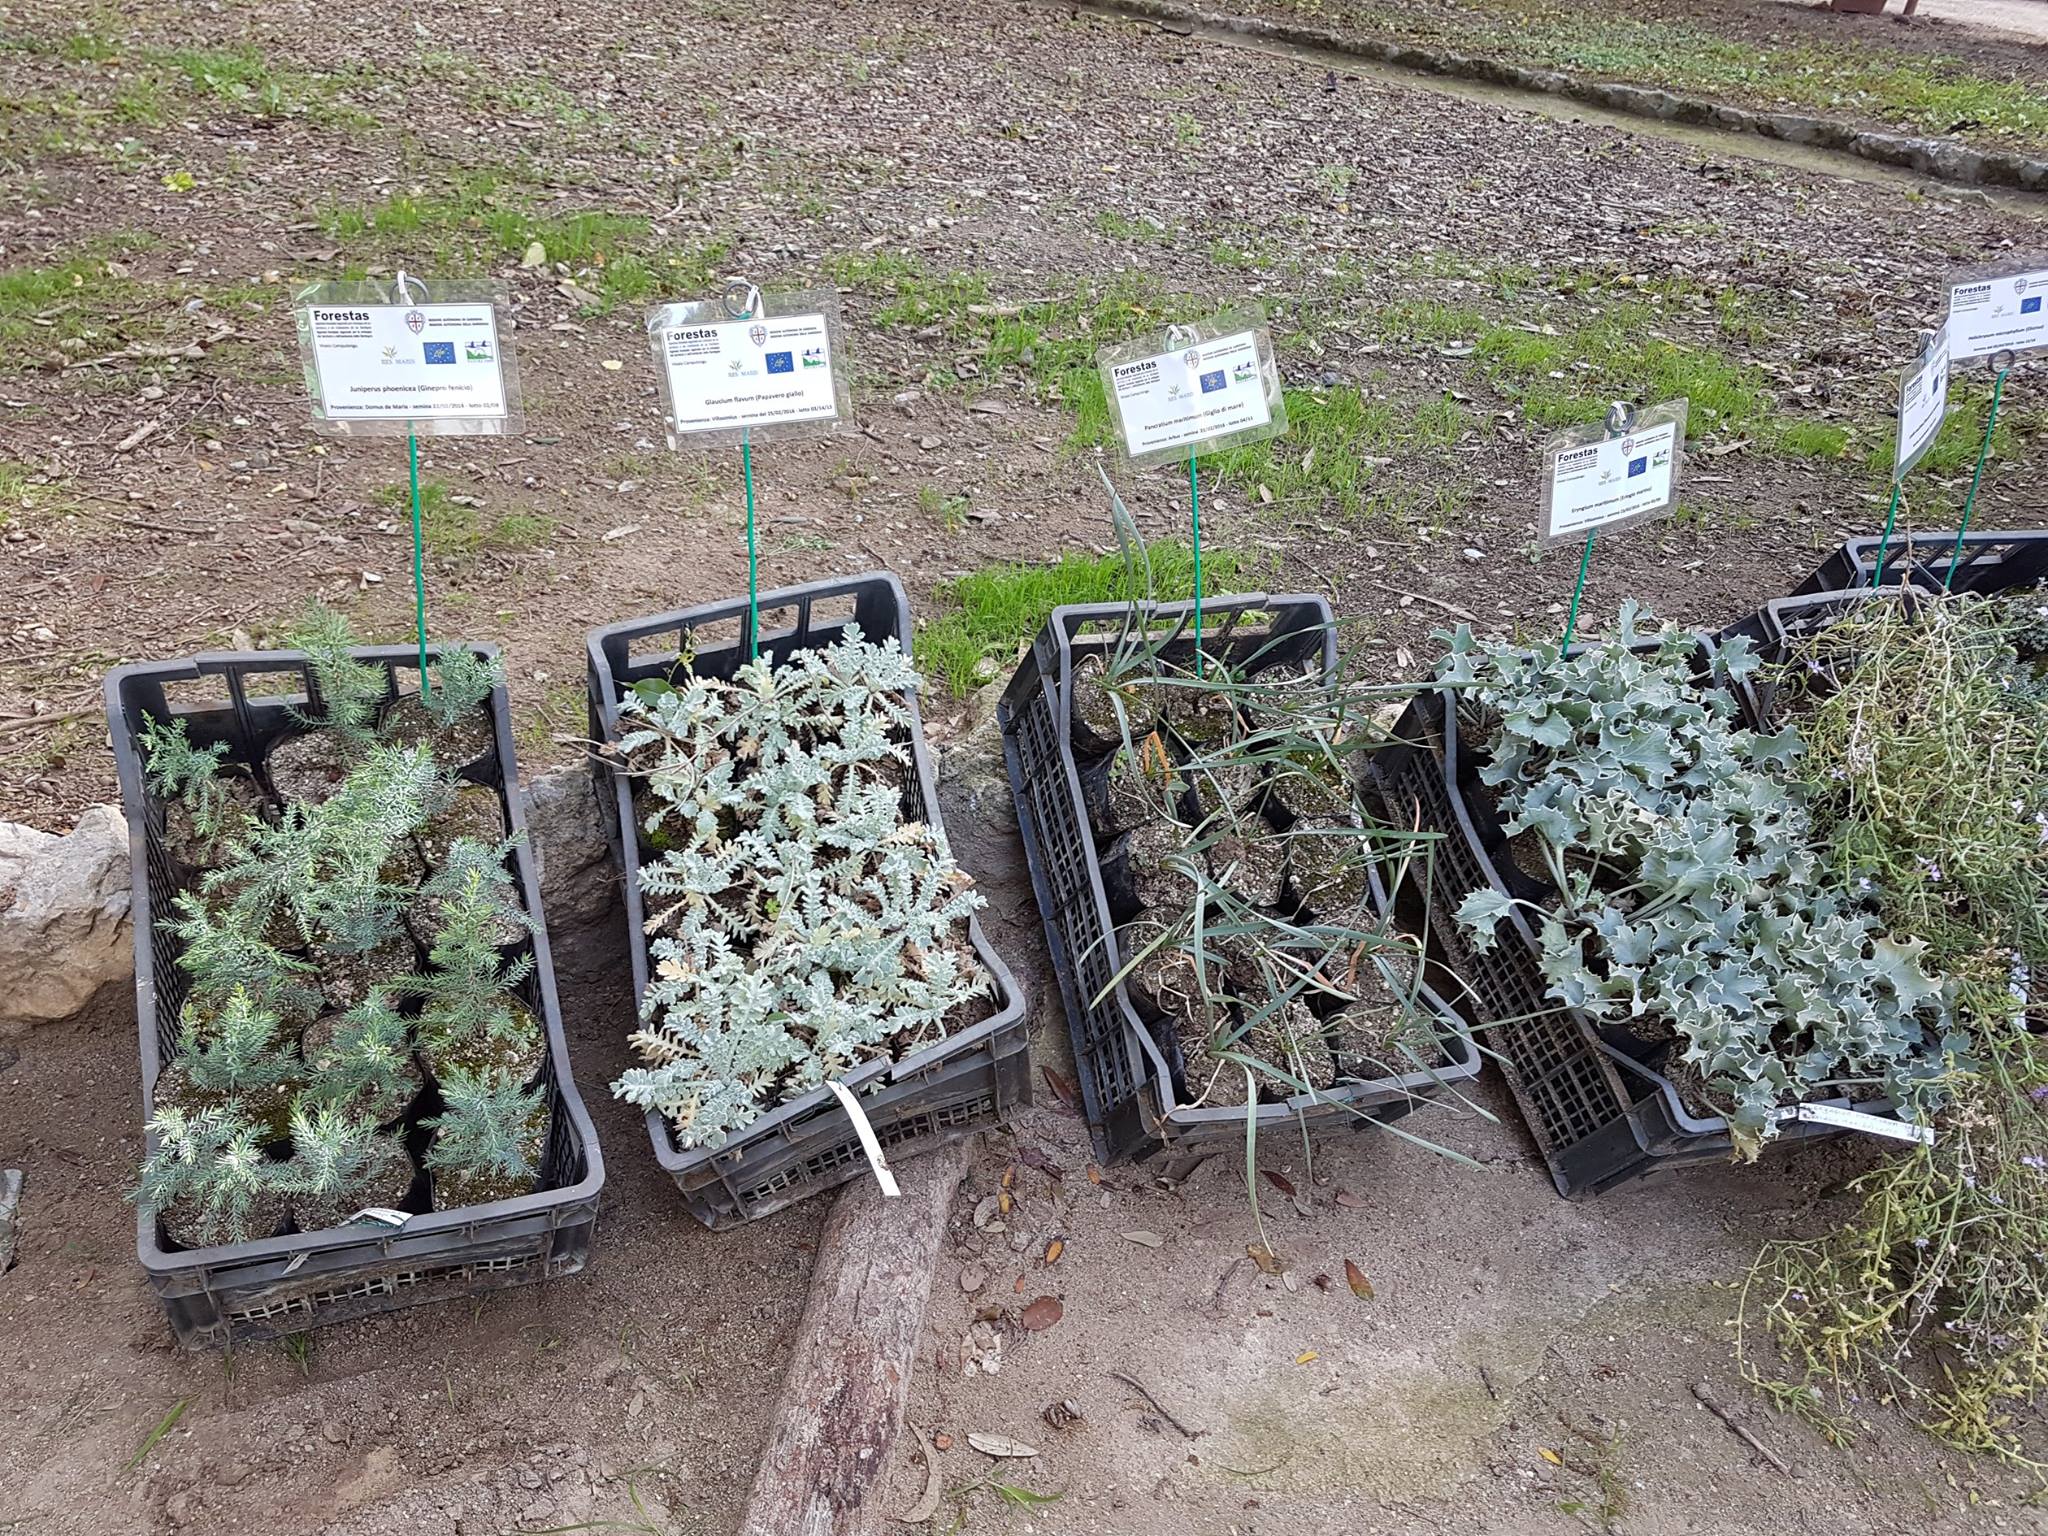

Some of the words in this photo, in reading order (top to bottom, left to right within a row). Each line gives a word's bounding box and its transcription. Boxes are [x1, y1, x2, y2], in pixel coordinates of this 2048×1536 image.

[1954, 284, 1991, 296] Forestas
[313, 310, 370, 321] Forestas
[666, 328, 718, 341] Forestas
[1114, 361, 1157, 377] Forestas
[382, 385, 416, 393] phoenicea
[705, 397, 733, 406] Glaucium
[734, 395, 754, 404] flavum
[755, 392, 785, 402] (Papavero
[786, 389, 804, 399] giallo)
[1558, 447, 1598, 463] Forestas
